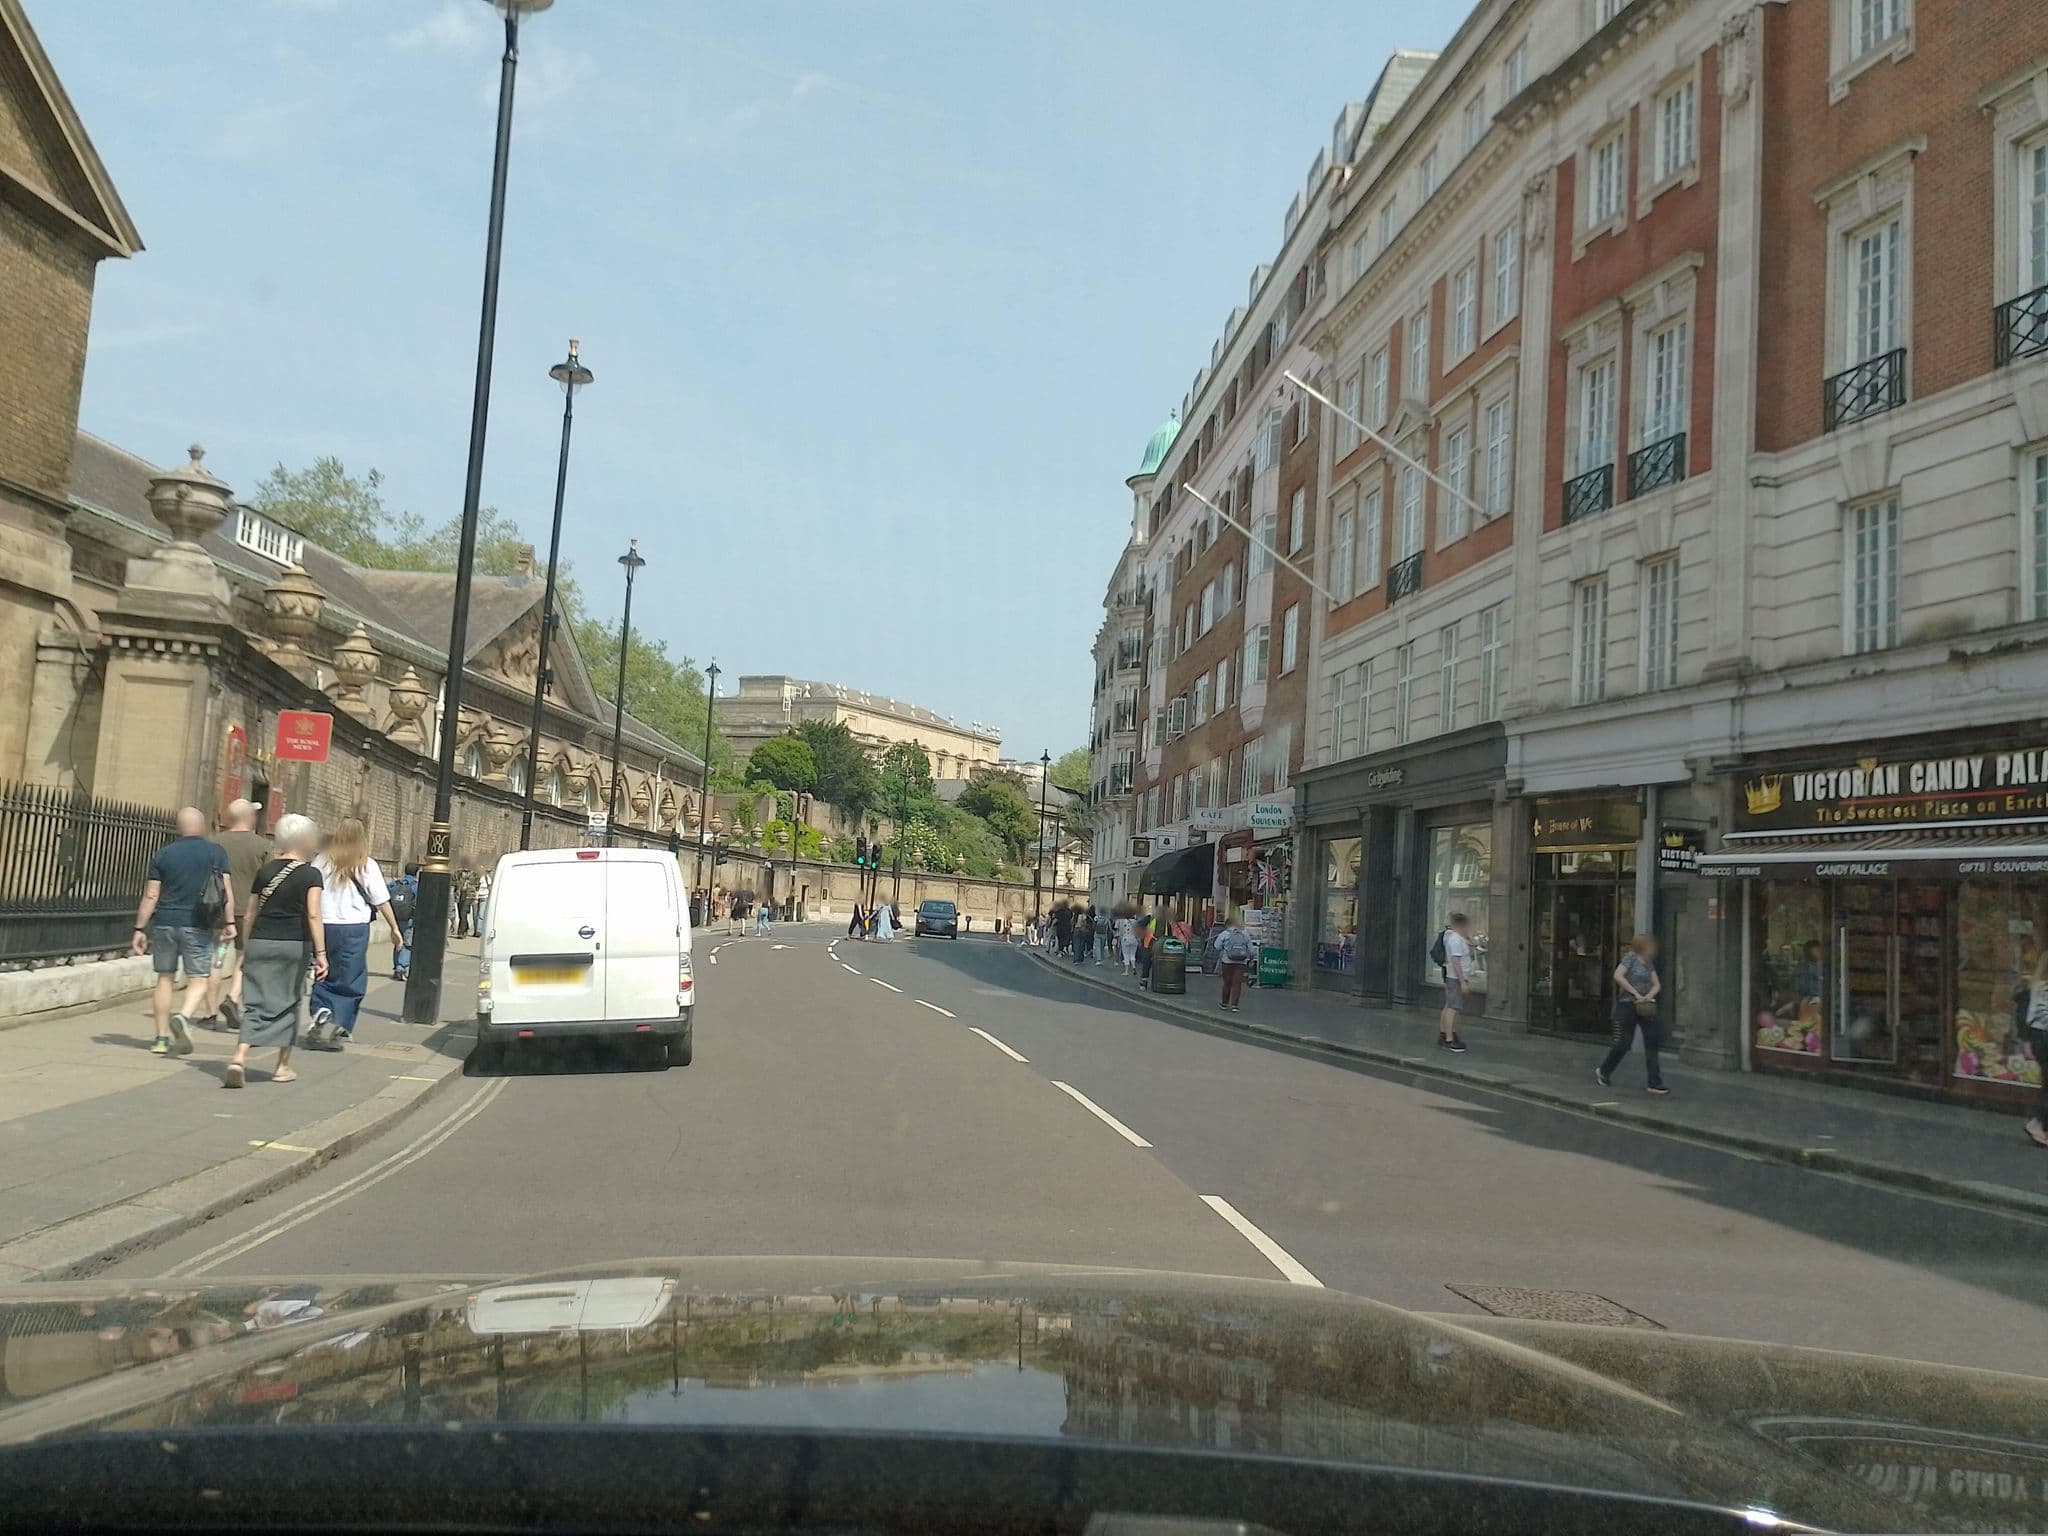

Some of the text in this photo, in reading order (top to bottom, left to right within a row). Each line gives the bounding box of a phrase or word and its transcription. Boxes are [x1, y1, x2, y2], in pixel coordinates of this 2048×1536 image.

[1792, 764, 1900, 802] VICTORIAN
[1909, 757, 1984, 793] CANDY
[1816, 793, 2048, 822] The Sweetest Place on Eart
[1815, 862, 1889, 876] CANDY PALACE
[1959, 862, 1985, 873] GIFTS
